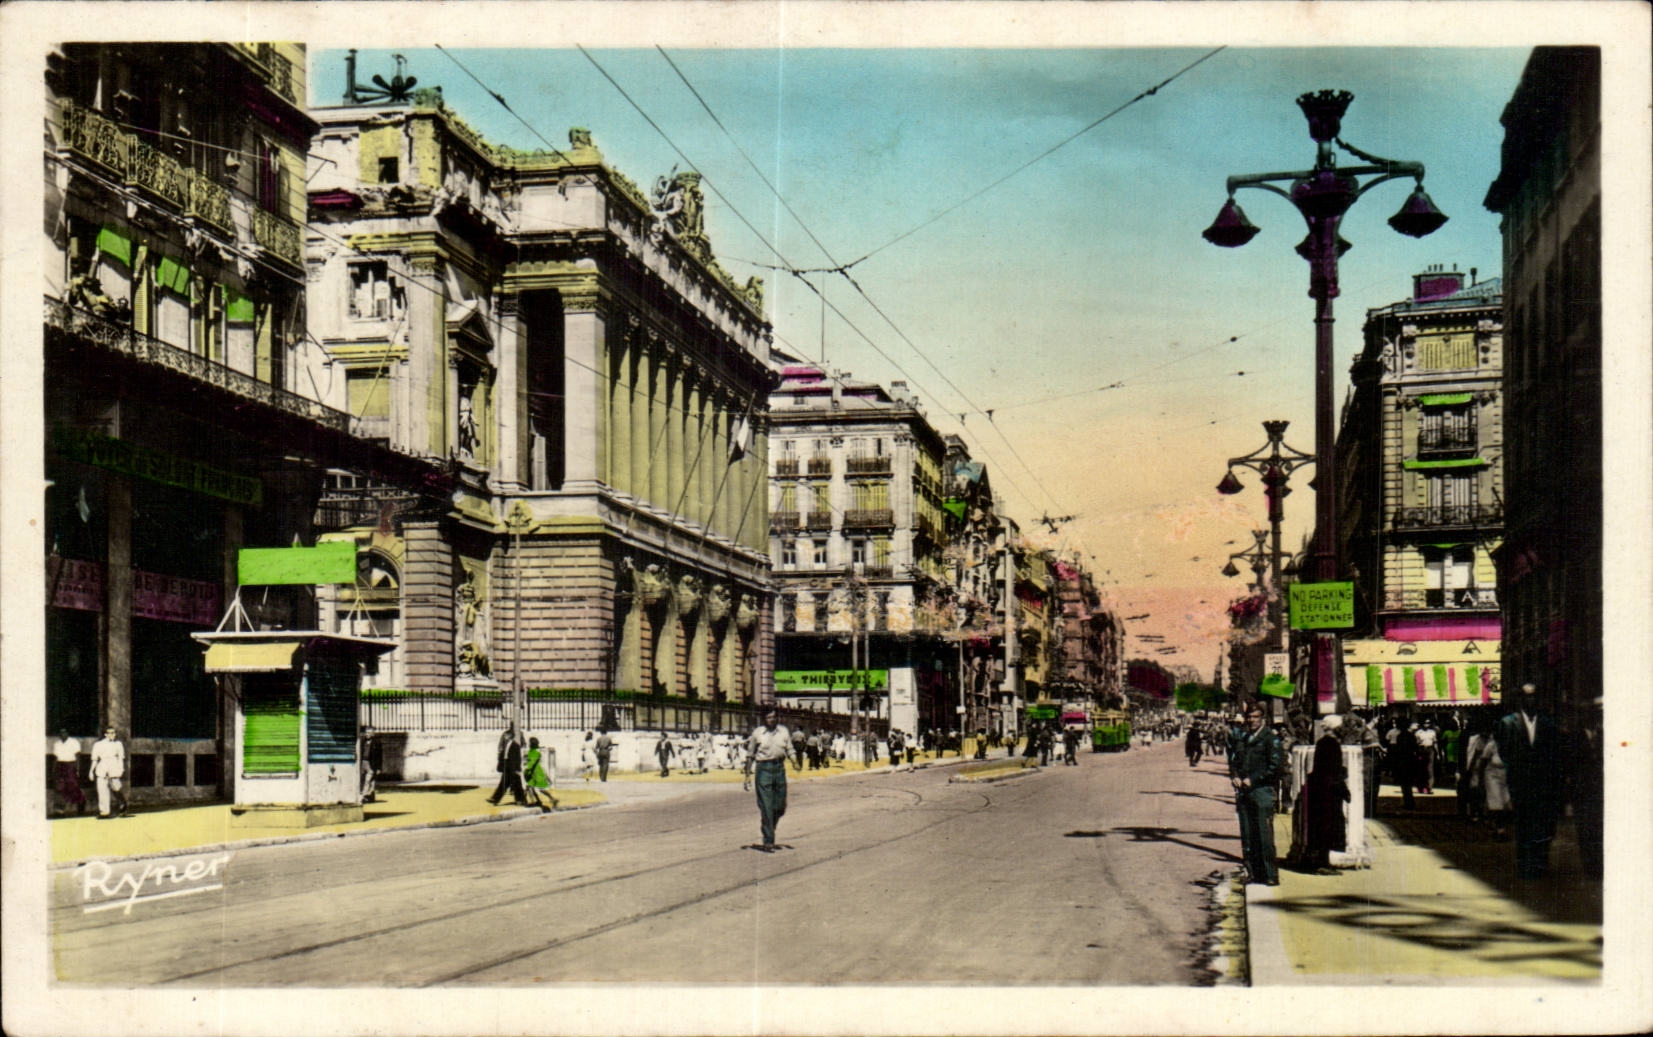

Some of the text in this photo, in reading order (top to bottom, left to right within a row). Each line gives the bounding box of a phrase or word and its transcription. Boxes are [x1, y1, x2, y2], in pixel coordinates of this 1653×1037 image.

[1292, 588, 1352, 602] NO PARKING
[1301, 602, 1342, 613] DEFENSE
[1299, 613, 1353, 624] STATIONNER
